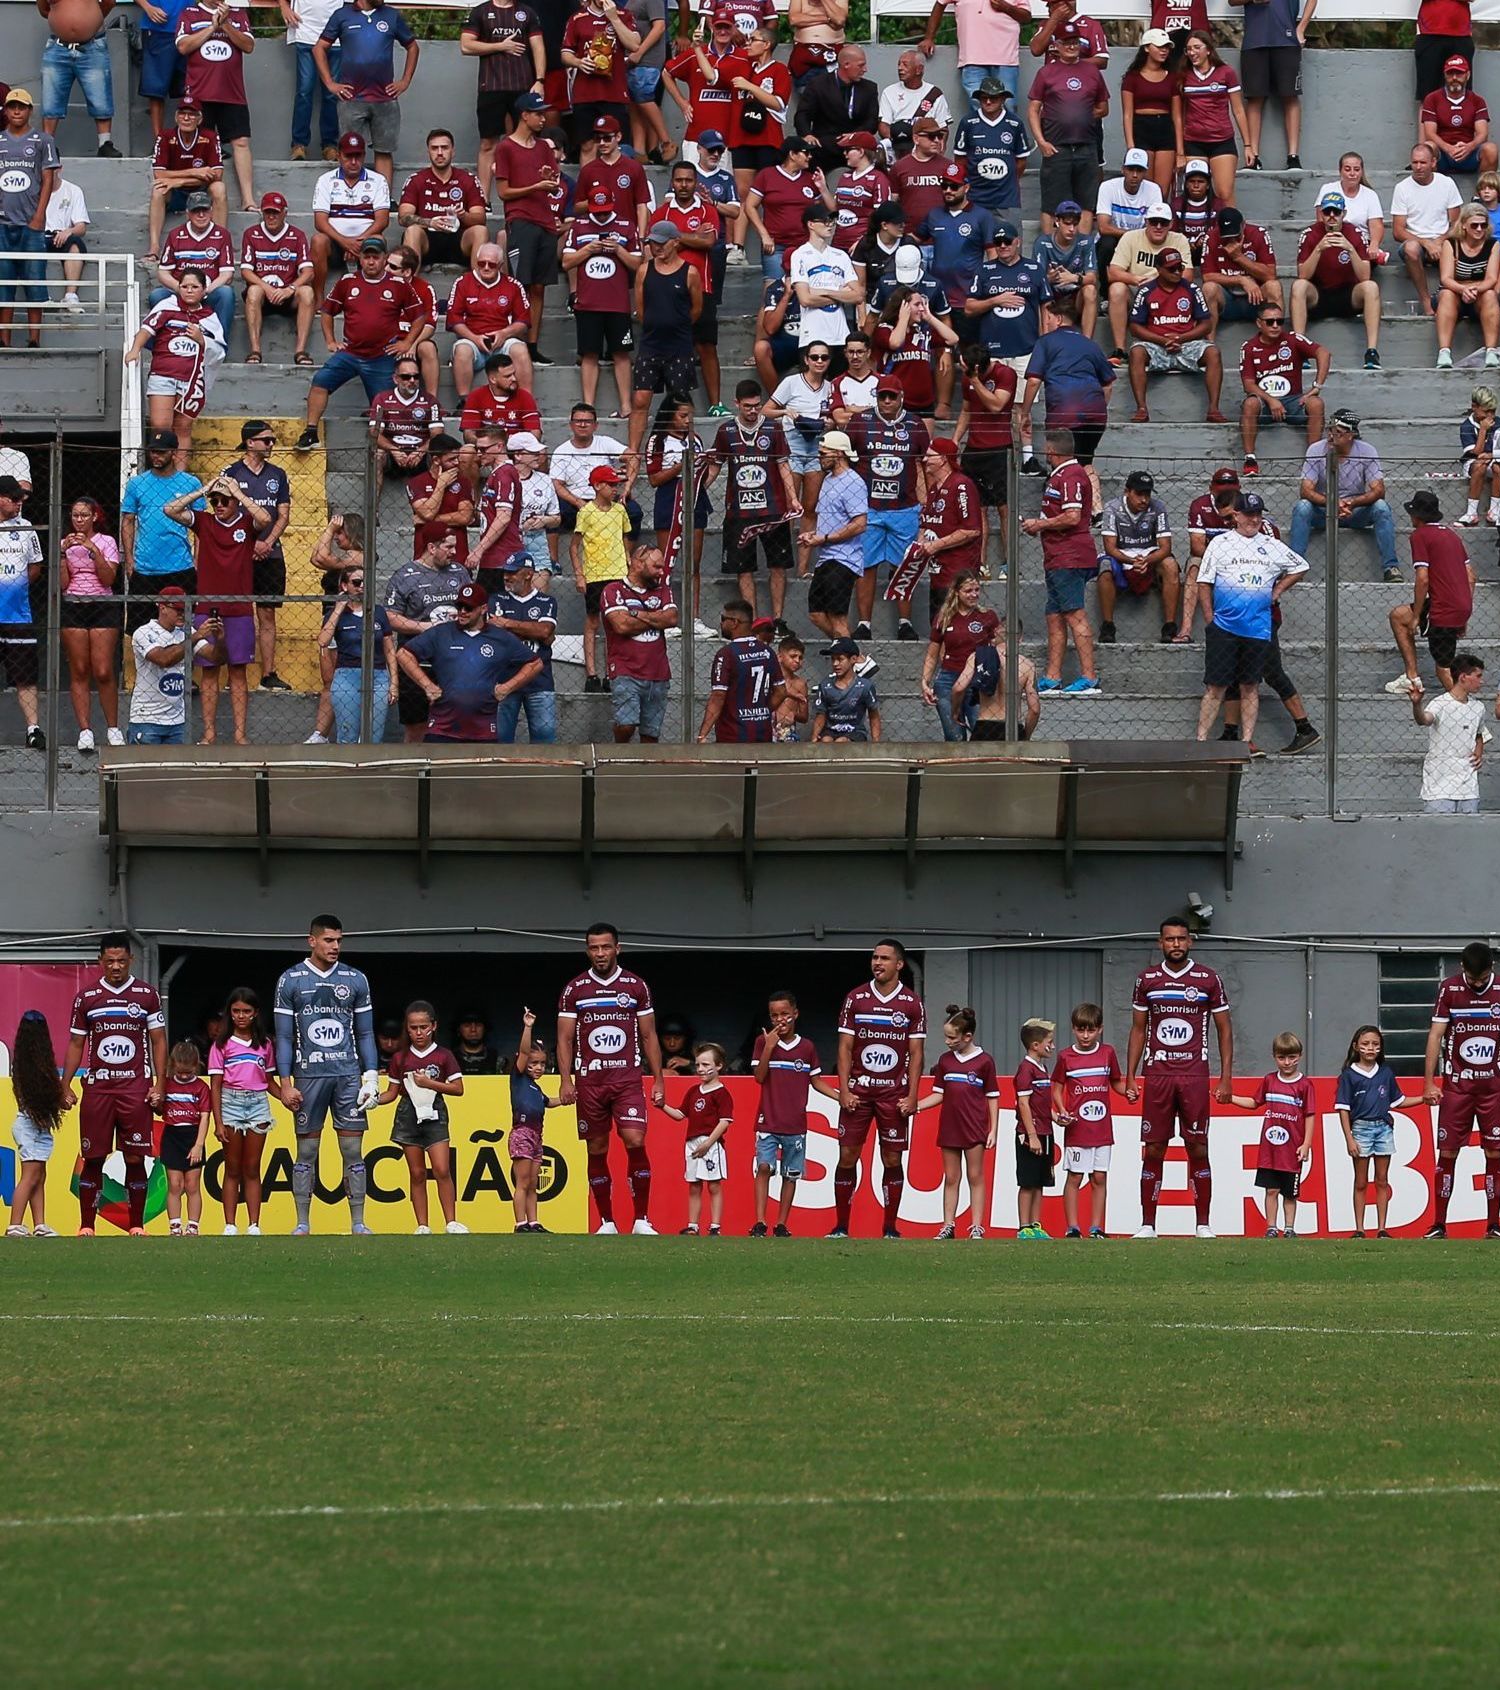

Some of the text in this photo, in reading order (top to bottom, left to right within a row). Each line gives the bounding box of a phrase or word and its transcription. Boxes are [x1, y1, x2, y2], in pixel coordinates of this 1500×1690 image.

[204, 45, 228, 56] SIM
[982, 163, 1005, 176] SIM
[3, 177, 27, 187] SIM
[589, 263, 611, 274] SIM
[1160, 315, 1192, 325] Banrisul
[891, 350, 922, 362] CAXIAS
[1262, 380, 1285, 391] SIM
[875, 442, 910, 452] Banrisul
[876, 458, 901, 471] SIM
[738, 470, 763, 482] SIM
[873, 481, 899, 493] ANC
[1238, 573, 1262, 586] SIM
[1160, 1004, 1199, 1014] banrisul
[314, 1026, 341, 1041] SIM
[1161, 1025, 1188, 1040] SIM
[1466, 1023, 1500, 1033] banrisu
[594, 1033, 622, 1046] SIM
[867, 1030, 906, 1041] banrisul
[103, 1042, 130, 1058] SIM
[1466, 1046, 1494, 1059] SIM
[864, 1052, 893, 1066] SIM
[1083, 1105, 1105, 1117] SIM
[1268, 1130, 1287, 1141] SIM
[1072, 1151, 1081, 1162] 10
